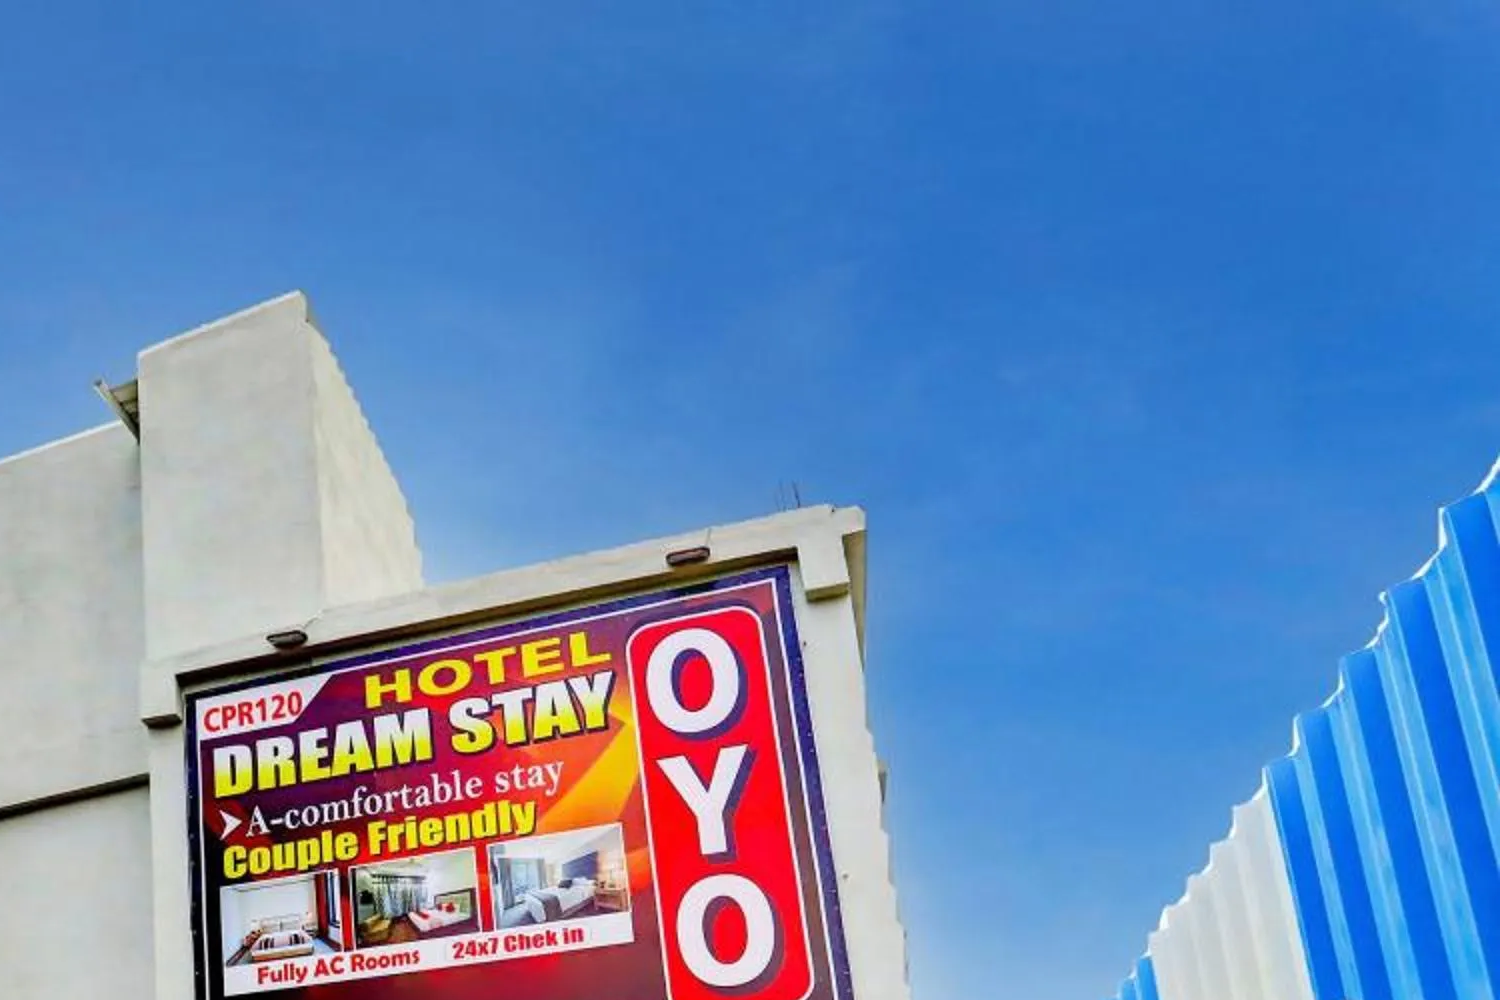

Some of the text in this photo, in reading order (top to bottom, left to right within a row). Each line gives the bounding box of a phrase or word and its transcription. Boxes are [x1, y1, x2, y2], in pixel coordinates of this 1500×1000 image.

[365, 631, 612, 709] HOTEL
[203, 691, 304, 732] CPR120
[213, 670, 614, 799] DREAM STAY
[245, 760, 564, 838] A-comfortable stay
[645, 627, 775, 988] OYO
[223, 799, 537, 880] Couple Friendly
[256, 949, 421, 986] Fully AC Rooms
[452, 928, 584, 961] 24x7 Chek in
